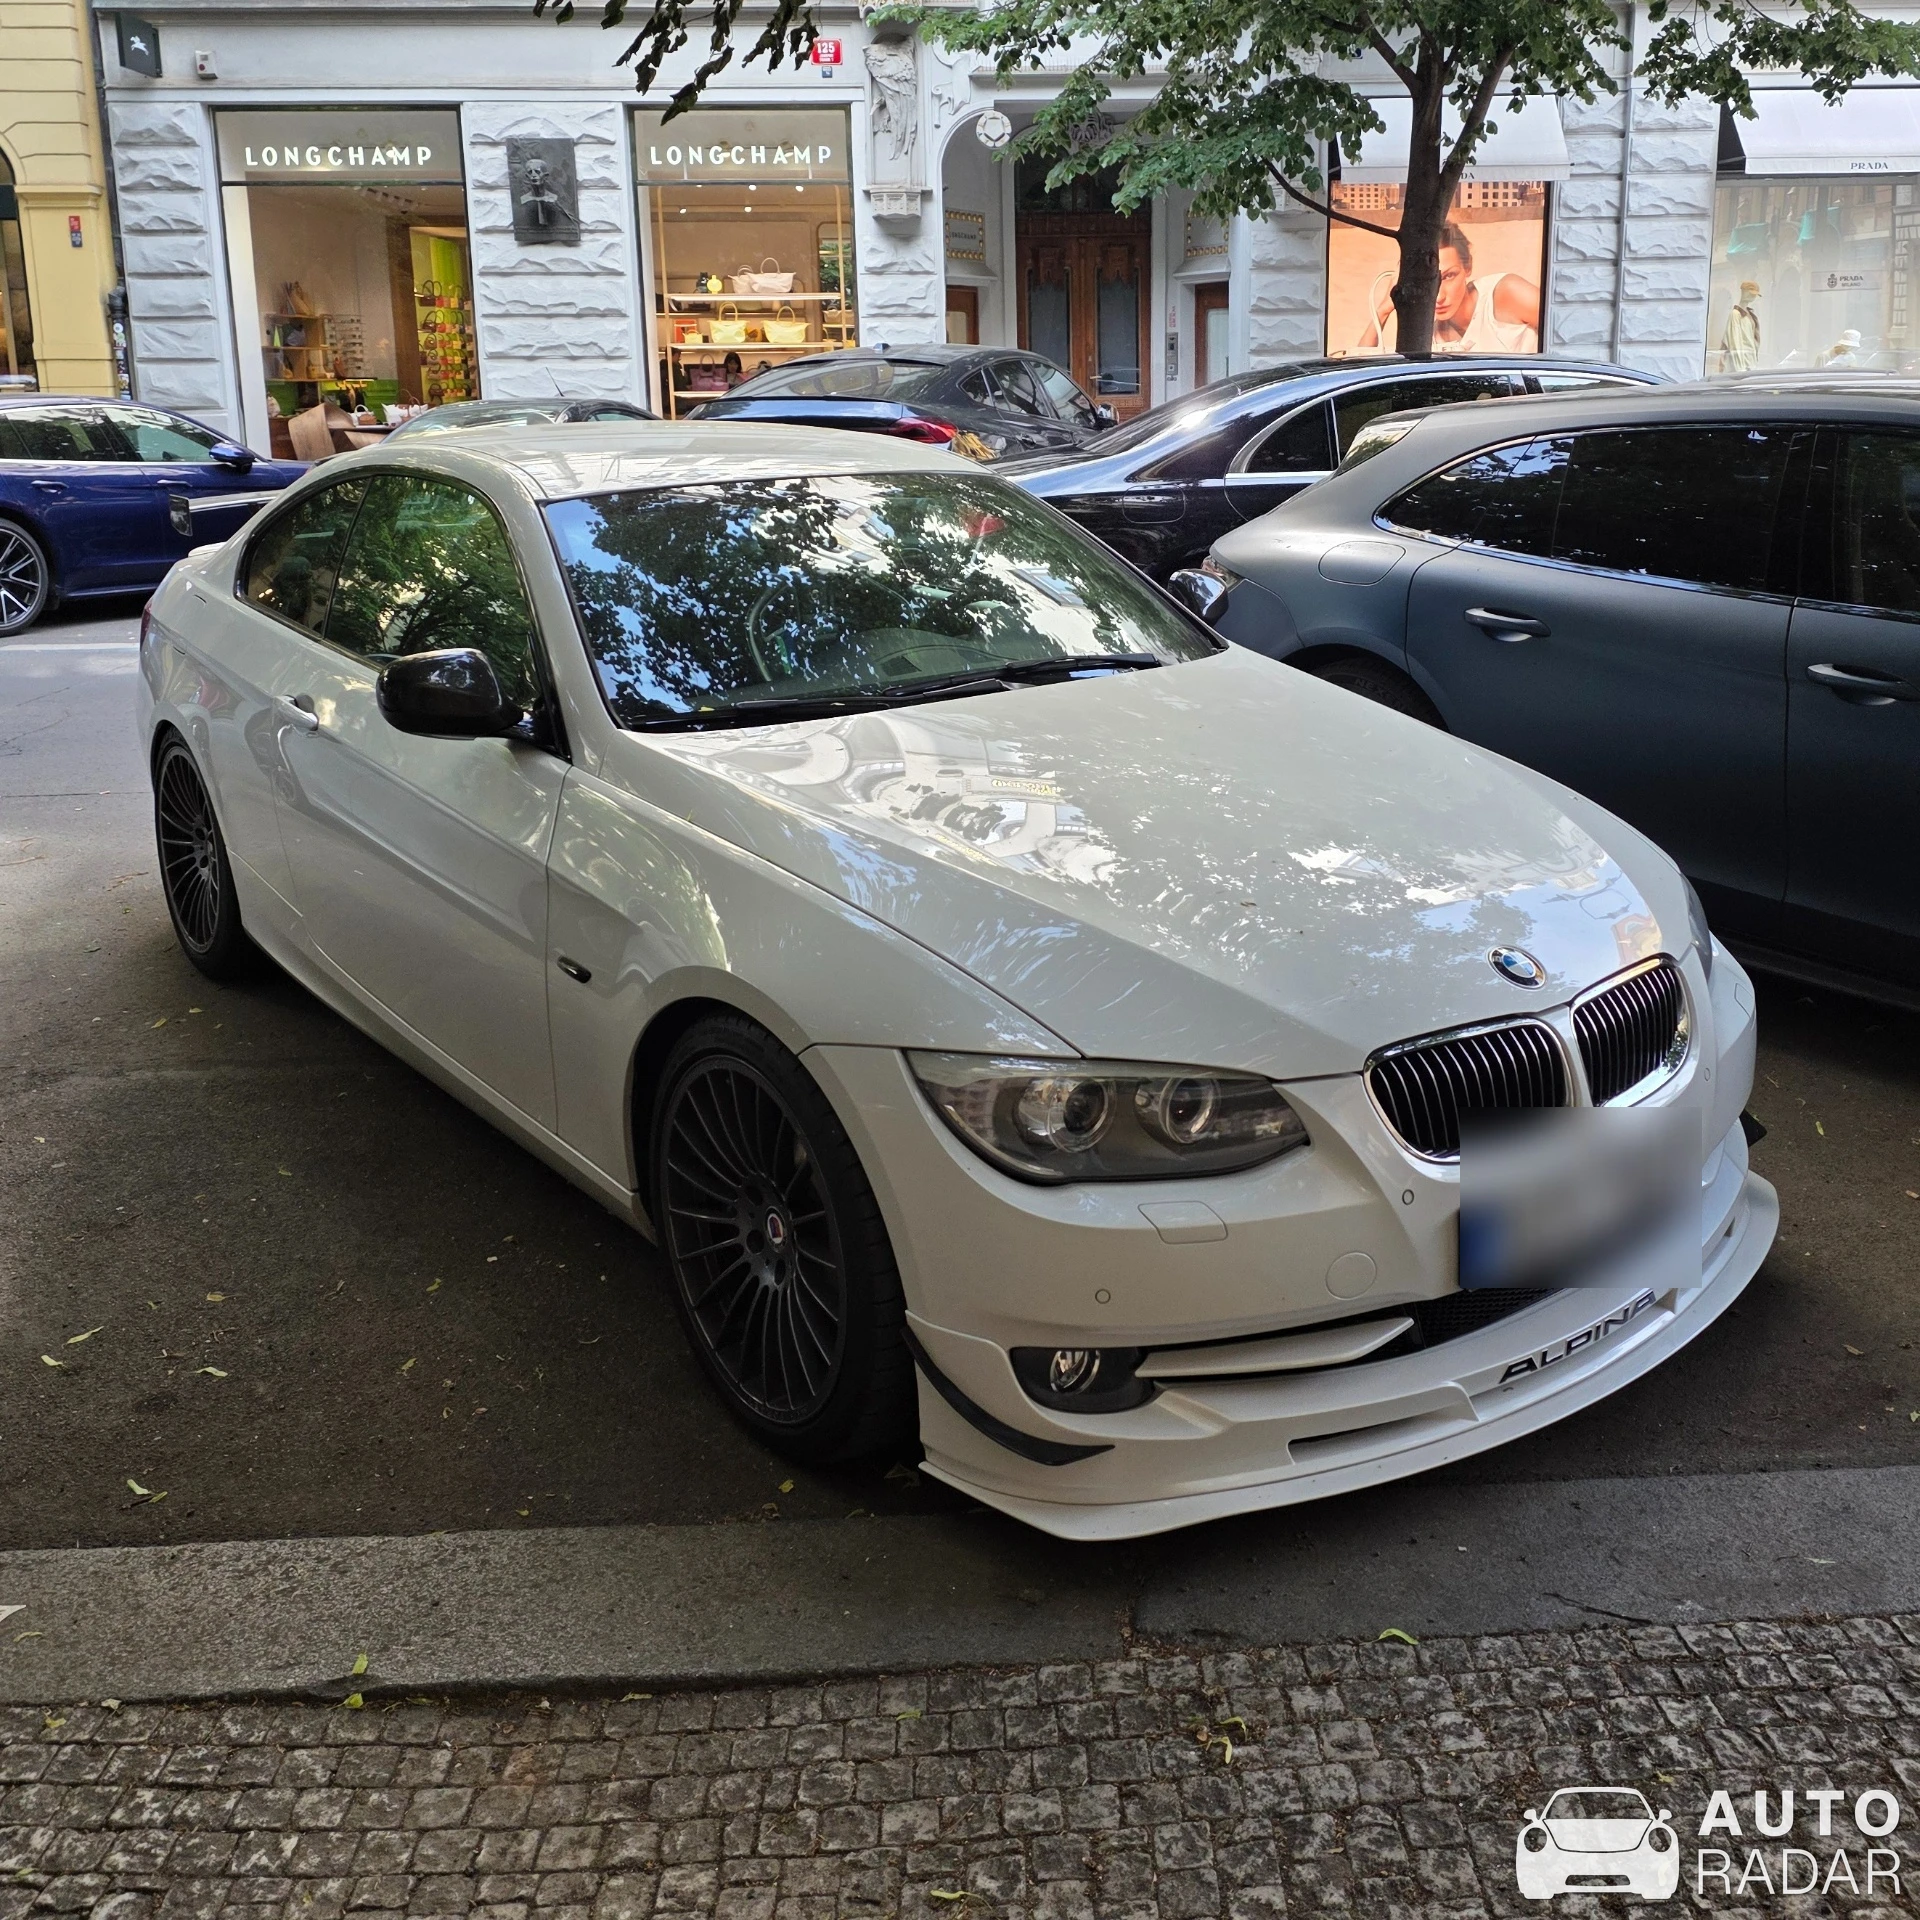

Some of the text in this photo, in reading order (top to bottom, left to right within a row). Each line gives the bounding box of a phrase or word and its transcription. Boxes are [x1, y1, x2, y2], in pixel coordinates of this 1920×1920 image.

[817, 42, 835, 54] 125
[245, 146, 432, 166] LONGCHAMP
[650, 146, 832, 166] LONGCHAMP
[1851, 162, 1888, 170] PRADA
[1499, 1290, 1657, 1384] ALPINA
